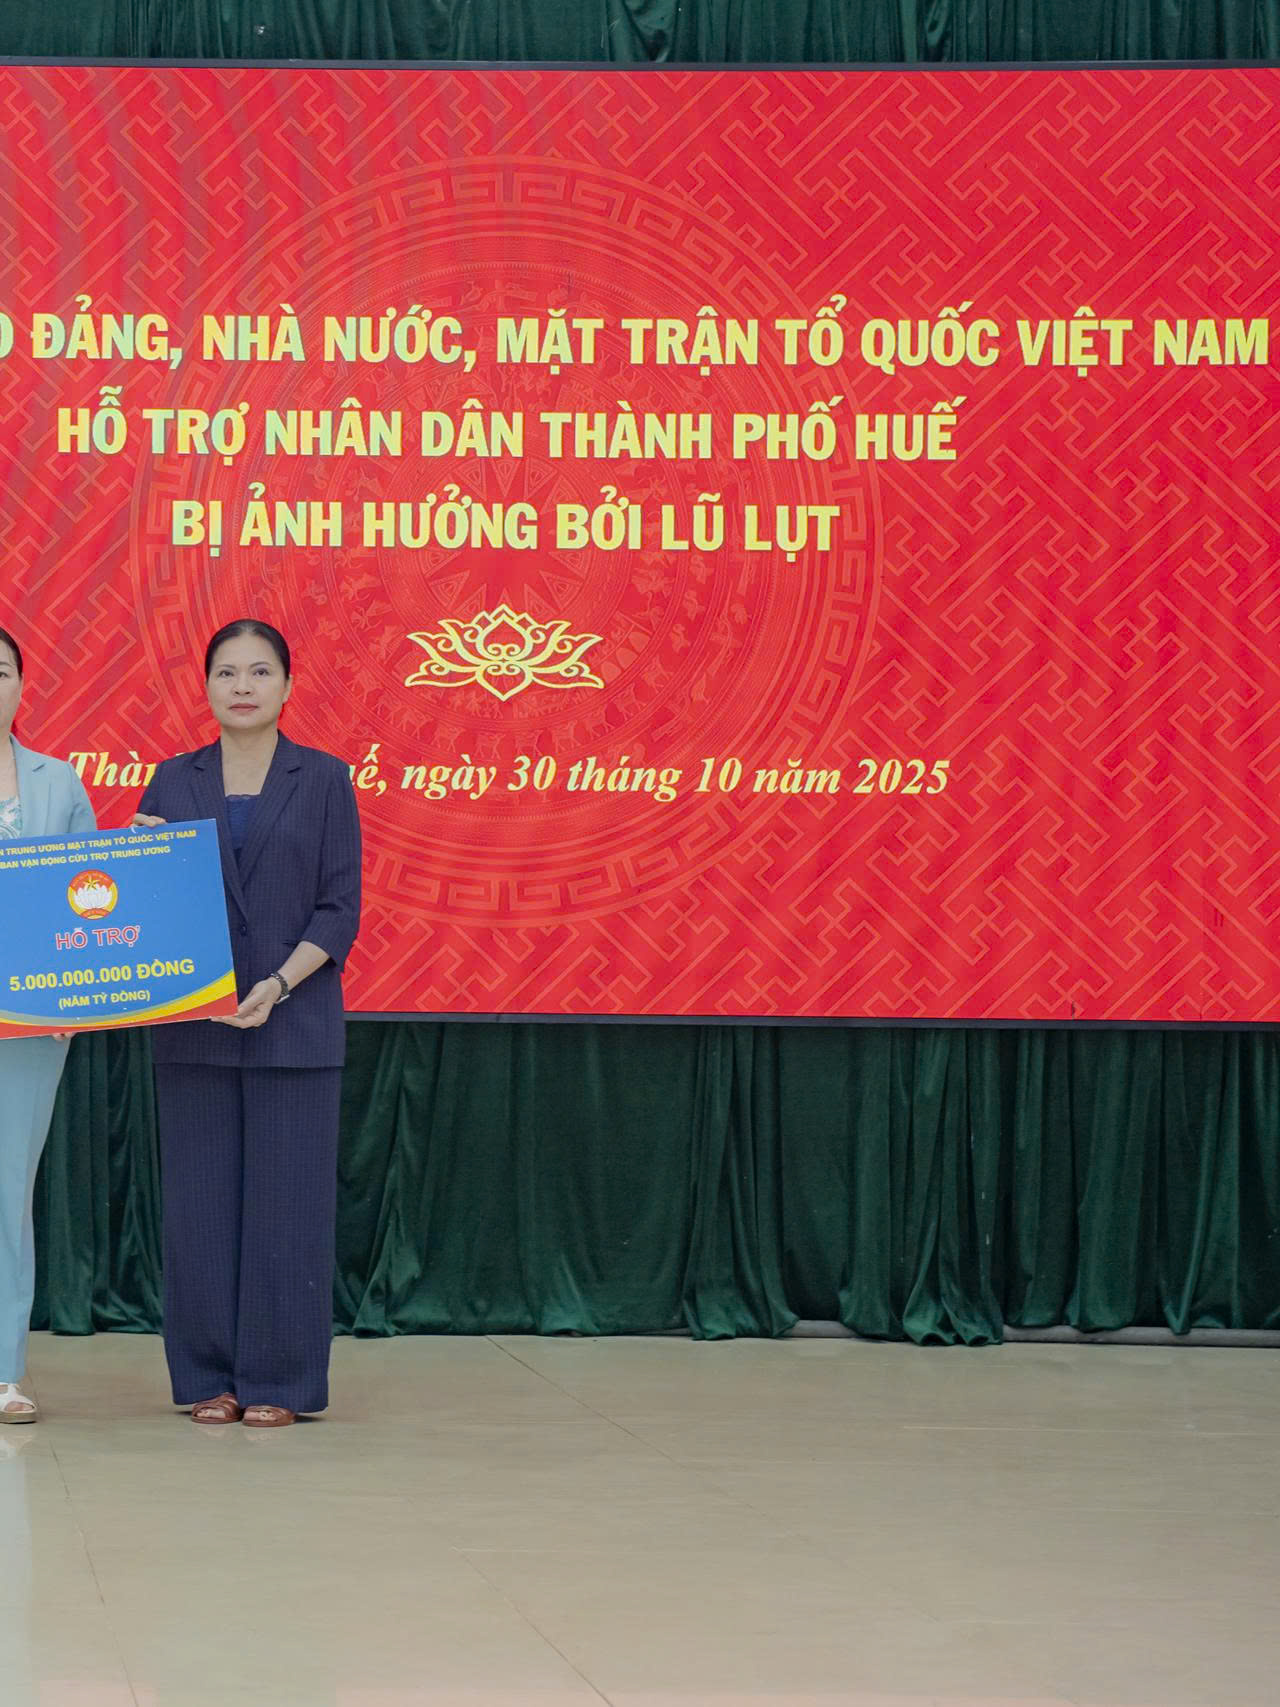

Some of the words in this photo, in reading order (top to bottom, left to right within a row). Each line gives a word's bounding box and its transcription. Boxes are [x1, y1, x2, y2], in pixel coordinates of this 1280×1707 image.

[30, 293, 183, 370] ĐẢNG,
[202, 303, 306, 362] NHÀ
[323, 303, 477, 373] NƯỚC,
[495, 308, 605, 375] MẶT
[621, 305, 759, 377] TRẬN
[774, 293, 847, 367] TỔ
[860, 300, 1000, 376] QUỐC
[1016, 305, 1133, 377] VIỆT
[1153, 318, 1269, 366] NAM
[57, 385, 128, 455] HỖ
[142, 401, 250, 466] TRỢ
[264, 396, 402, 457] NHÂN
[421, 397, 524, 458] DÂN
[539, 399, 713, 459] THÀNH
[732, 395, 844, 461] PHỐ
[855, 395, 967, 461] HUẾ
[172, 499, 223, 558] BỊ
[239, 481, 343, 547] ẢNH
[362, 483, 538, 550] HƯỞNG
[556, 484, 642, 551] BỞI
[661, 492, 724, 551] LŨ
[744, 504, 841, 563] LỤT
[400, 753, 497, 801] ngày
[507, 755, 557, 792] 30
[567, 755, 683, 803] tháng
[694, 757, 743, 794] 10
[752, 757, 842, 795] năm
[852, 758, 951, 795] 2025
[0, 860, 19, 870] BAN
[111, 848, 141, 859] TRUNG
[6, 846, 36, 856] TRUNG
[176, 829, 197, 839] NAM
[92, 925, 141, 948] TRỢ
[9, 964, 132, 992] 5.000.000.000
[136, 958, 195, 980] ĐỒNG
[58, 994, 90, 1010] (NĂM
